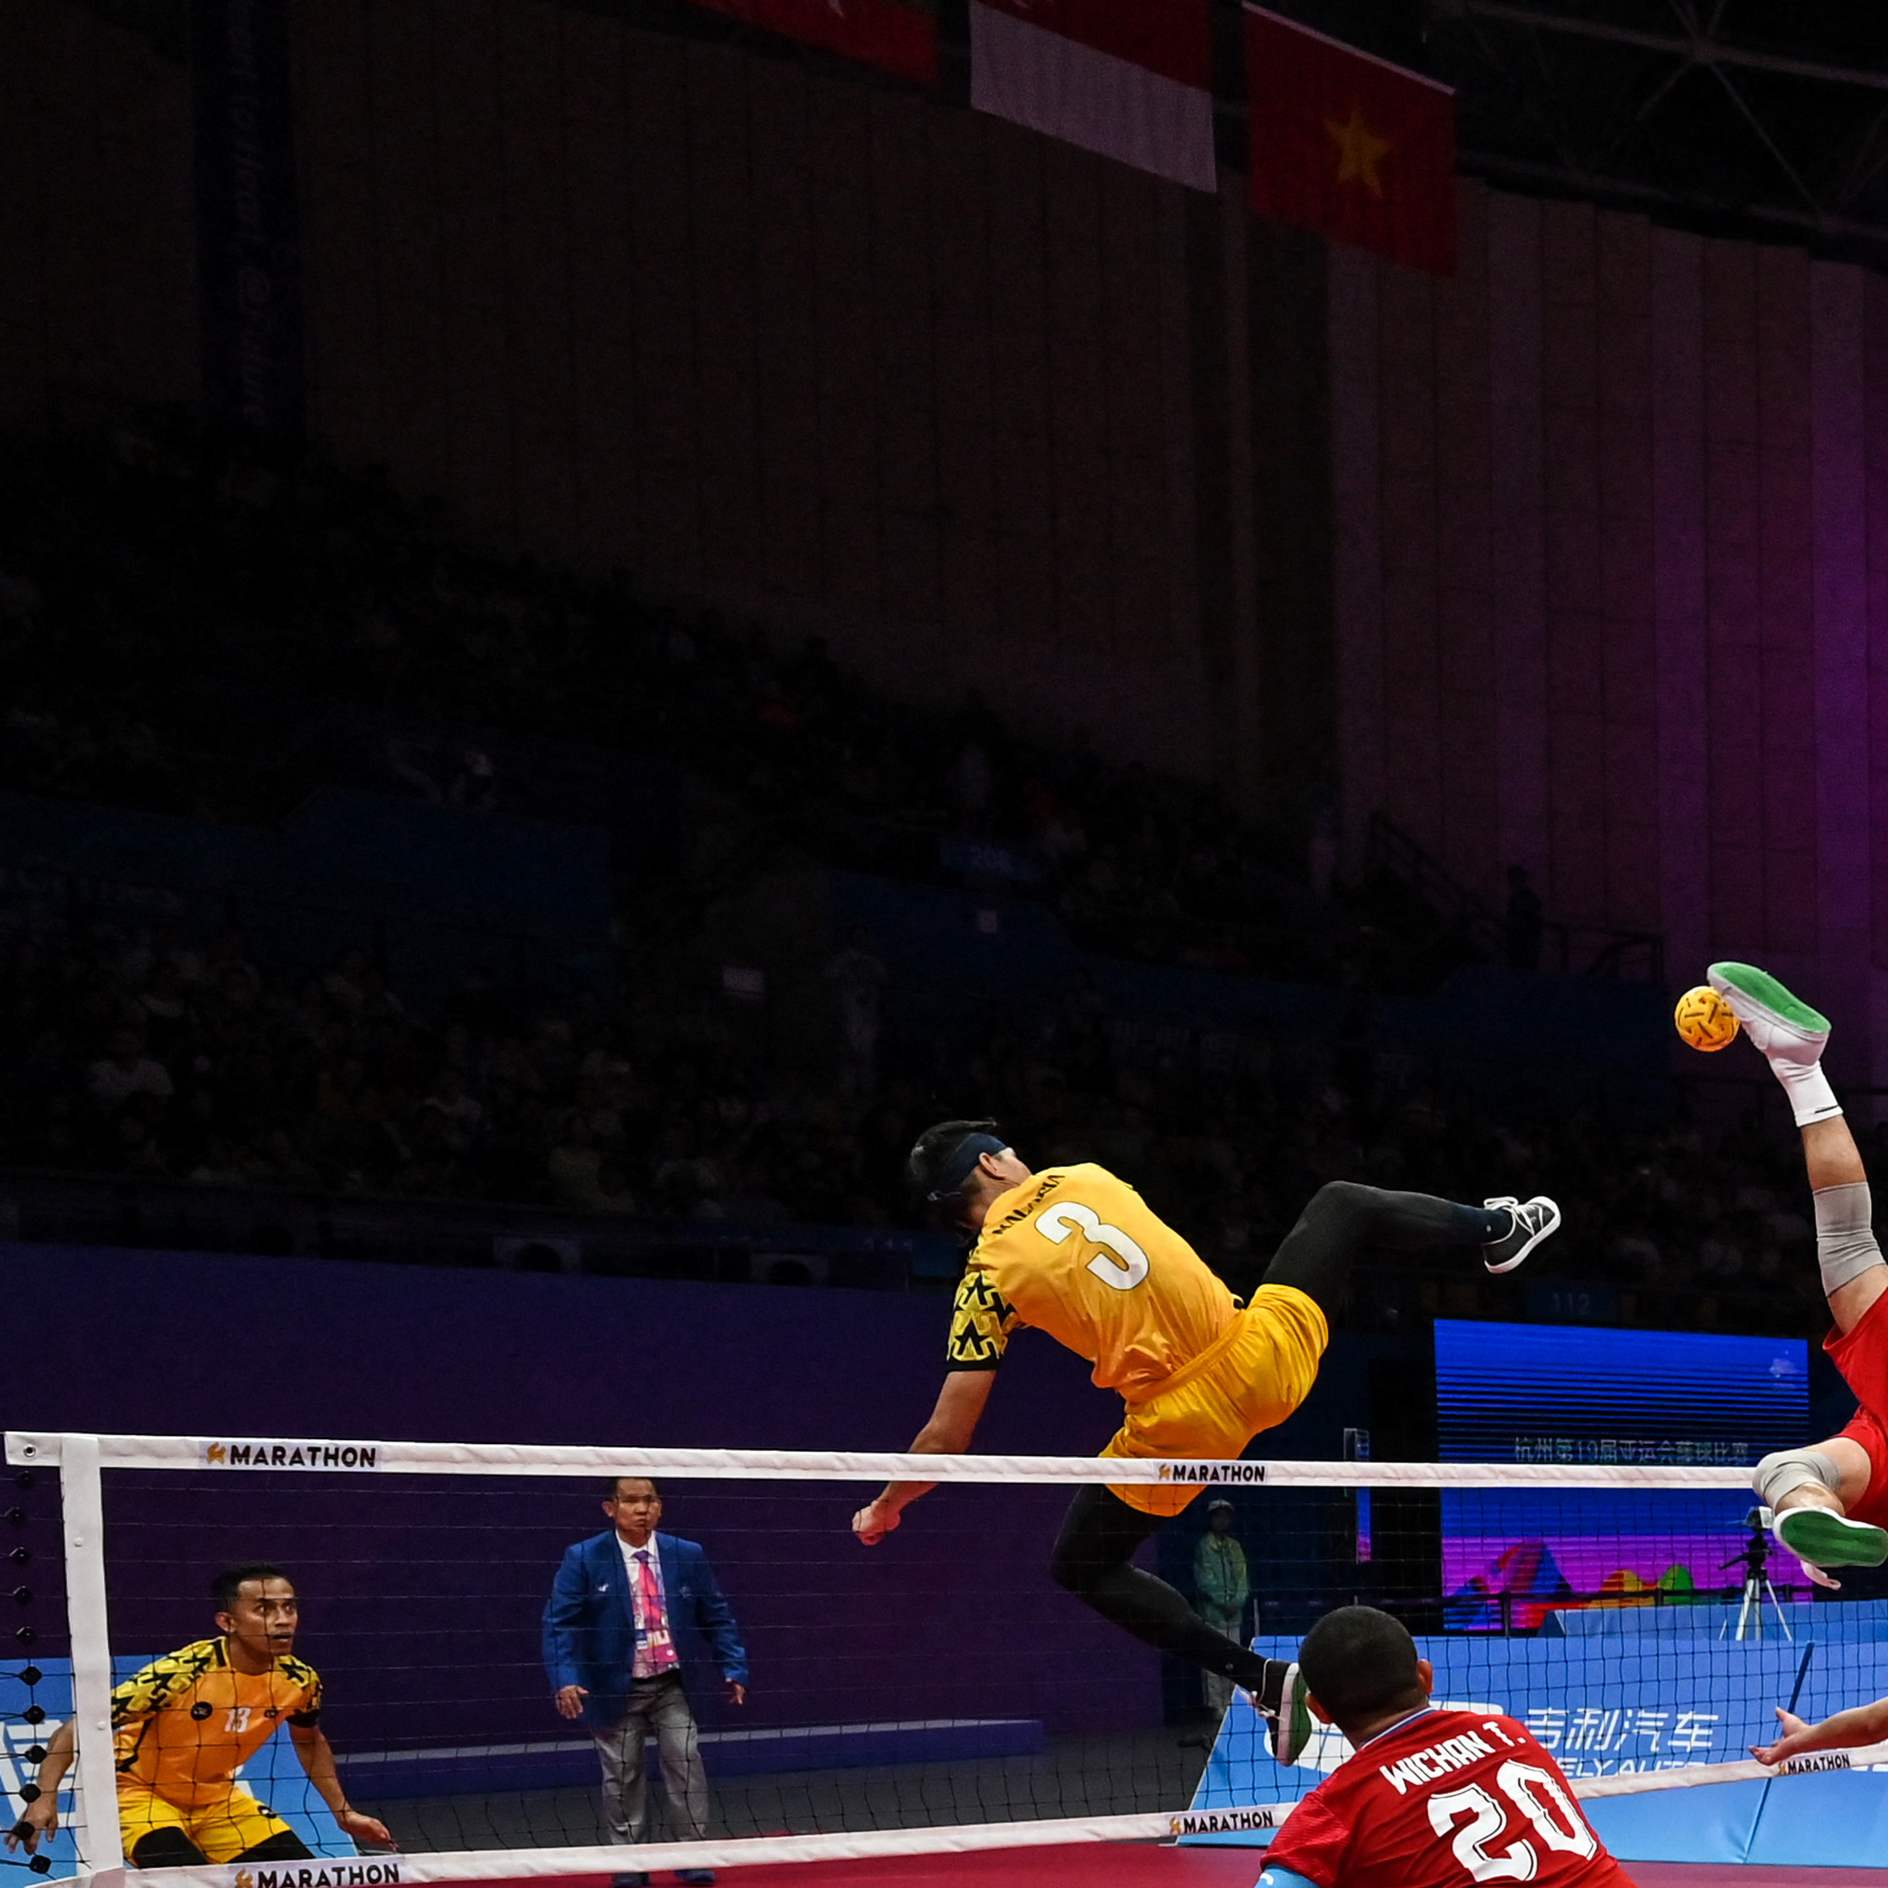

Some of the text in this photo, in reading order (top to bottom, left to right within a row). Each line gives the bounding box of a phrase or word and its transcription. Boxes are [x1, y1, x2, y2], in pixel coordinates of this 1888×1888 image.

[1034, 1200, 1150, 1291] 3
[229, 1443, 377, 1468] MARATHON
[1172, 1464, 1266, 1482] MARATHON
[224, 1707, 251, 1733] 13
[1523, 1707, 1720, 1753] 吉利汽车
[1379, 1721, 1526, 1795] WICHAN T.
[1787, 1753, 1852, 1776] MARATHON
[1427, 1758, 1598, 1883] 20
